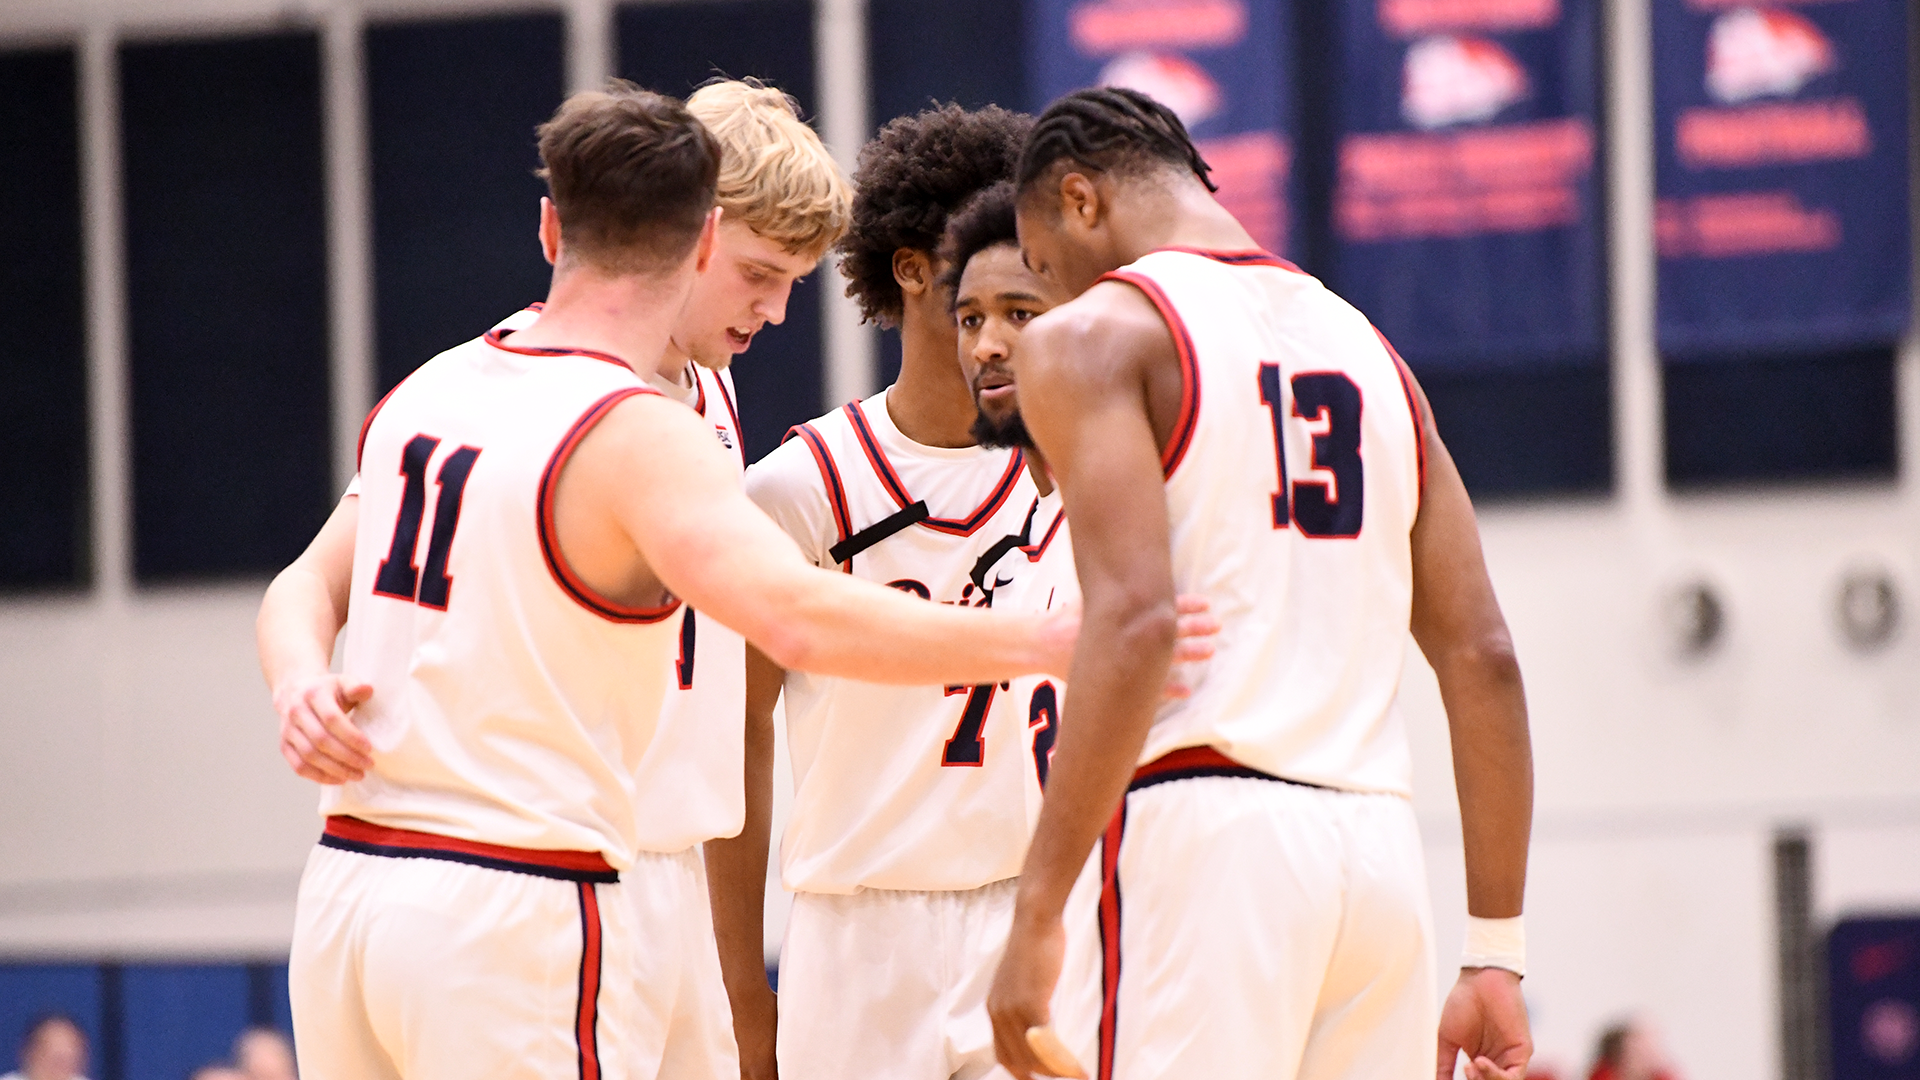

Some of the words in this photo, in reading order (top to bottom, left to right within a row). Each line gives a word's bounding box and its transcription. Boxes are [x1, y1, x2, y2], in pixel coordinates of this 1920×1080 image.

[372, 432, 483, 612] 11
[1257, 361, 1364, 539] 13
[941, 682, 998, 767] 7
